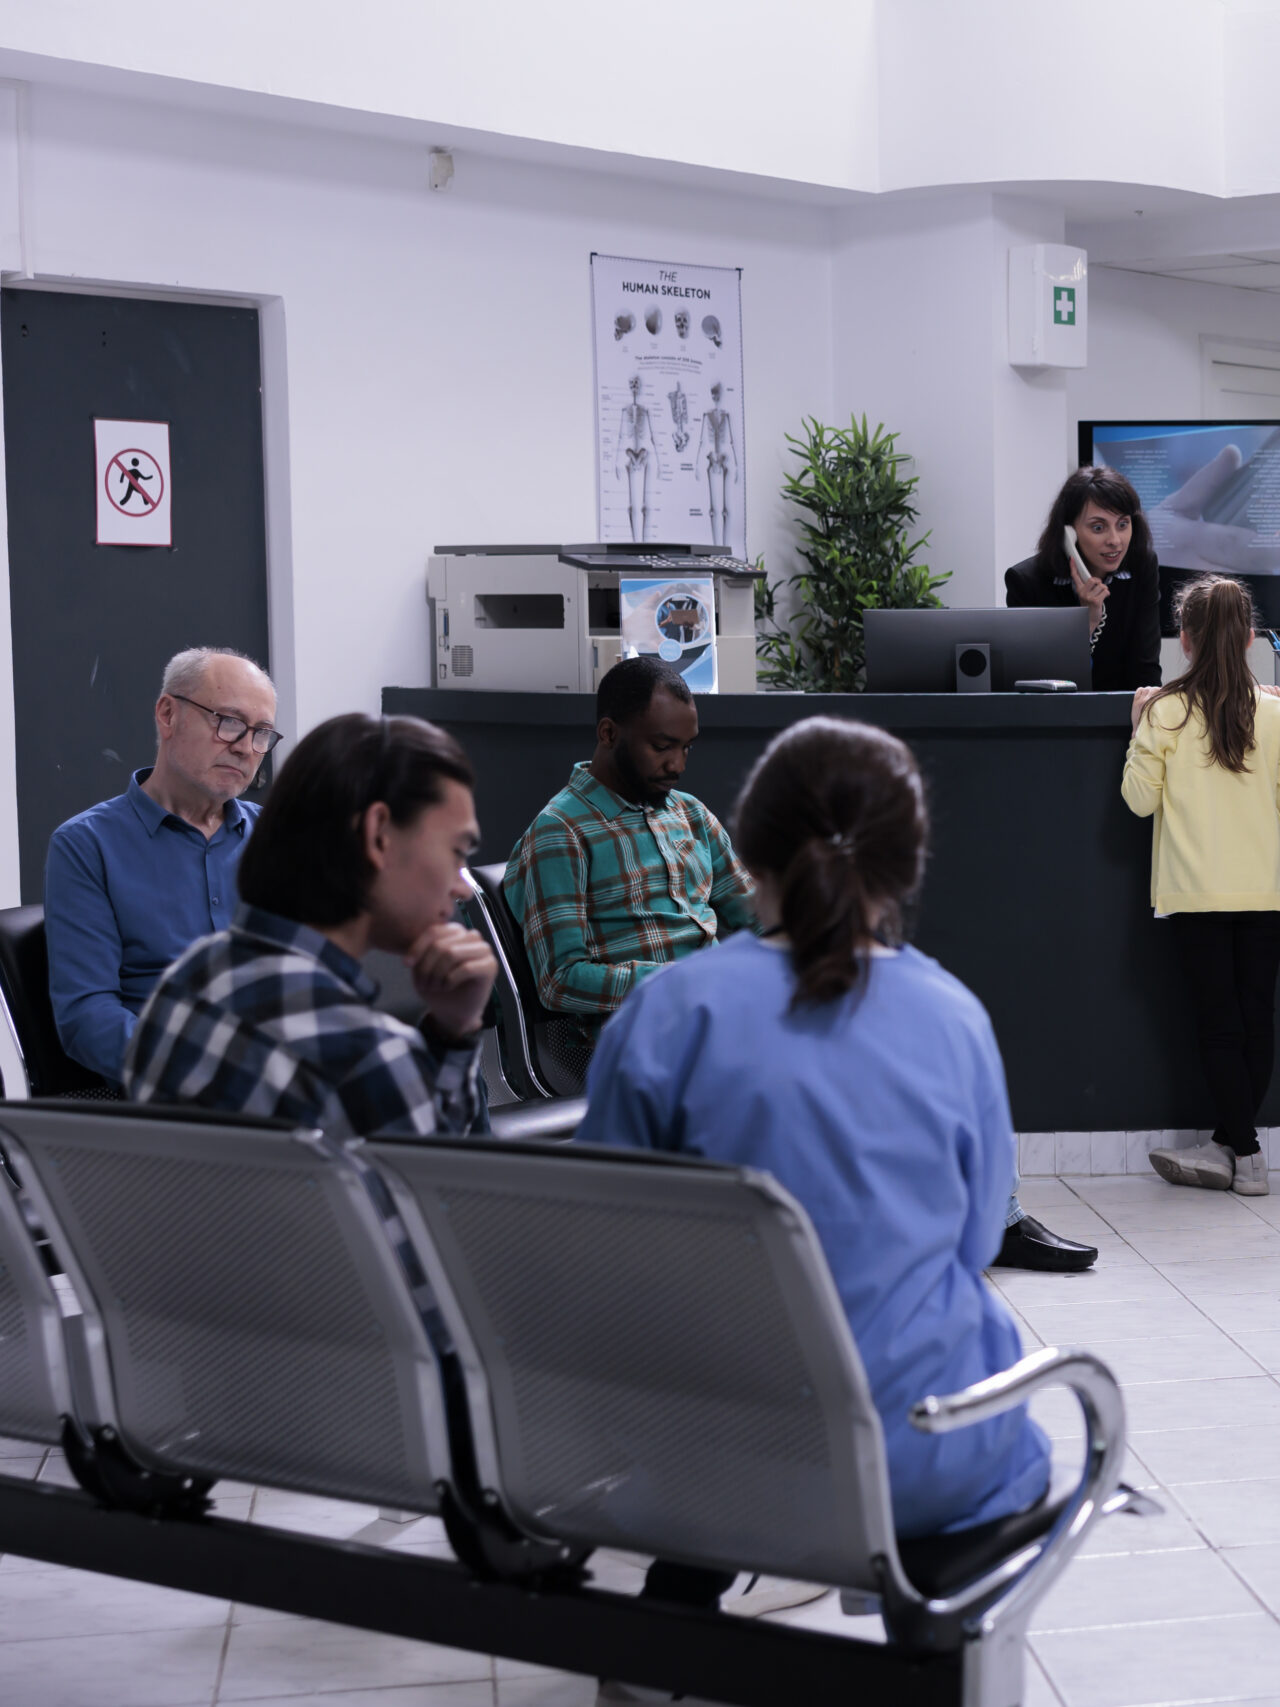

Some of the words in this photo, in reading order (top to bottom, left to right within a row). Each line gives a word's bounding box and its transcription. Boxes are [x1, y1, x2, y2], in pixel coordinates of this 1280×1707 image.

[659, 270, 677, 282] THE
[622, 281, 659, 295] HUMAN
[661, 285, 711, 300] SKELETON
